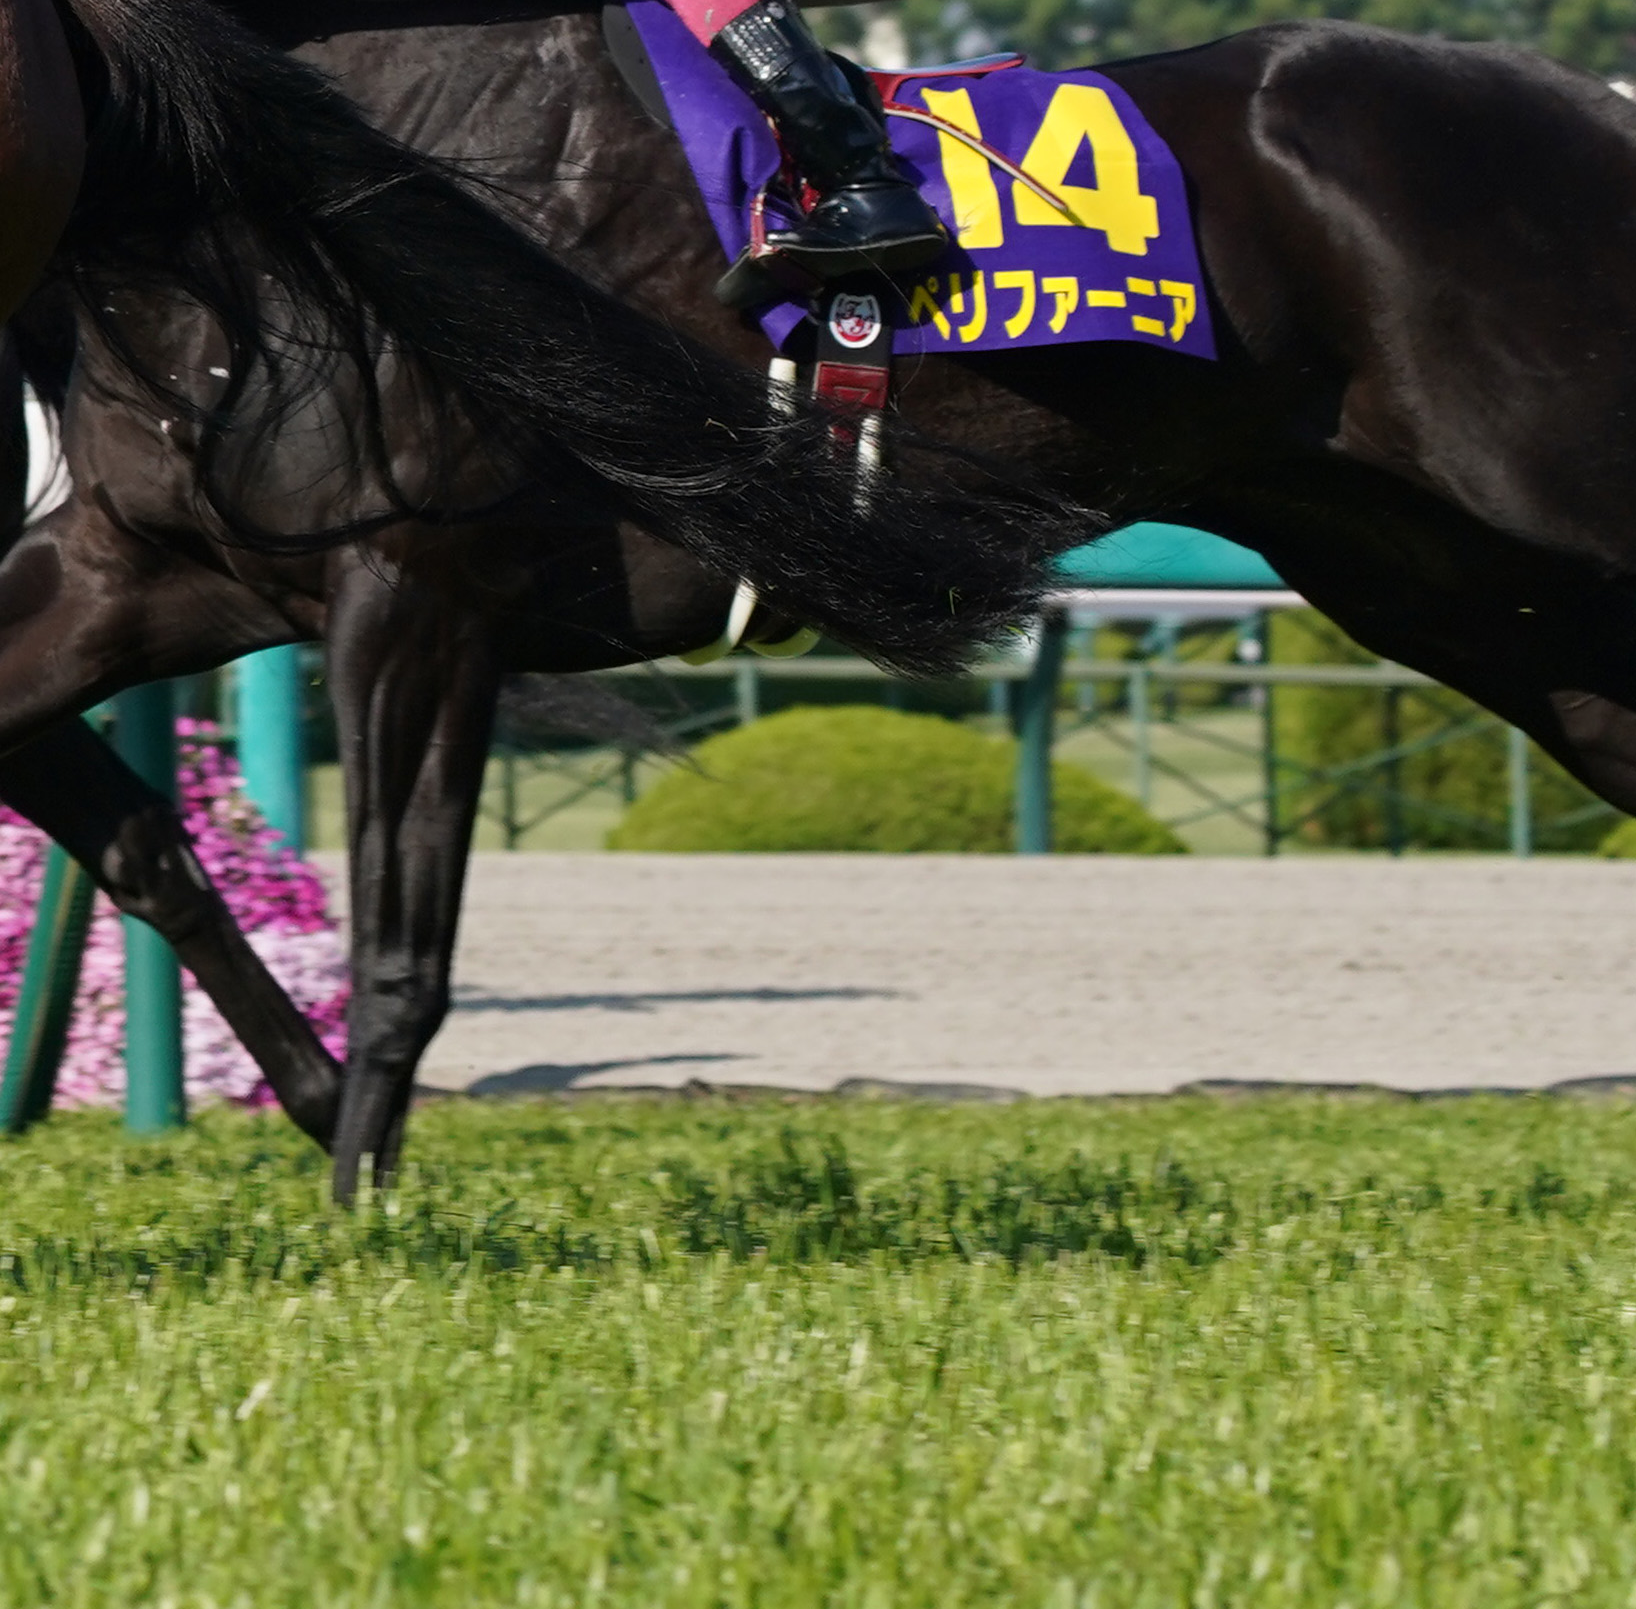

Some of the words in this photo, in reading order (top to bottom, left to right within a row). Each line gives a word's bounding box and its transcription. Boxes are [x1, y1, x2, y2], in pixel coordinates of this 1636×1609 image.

[921, 84, 1160, 257] 14
[908, 269, 1197, 344] ペリファーニア
